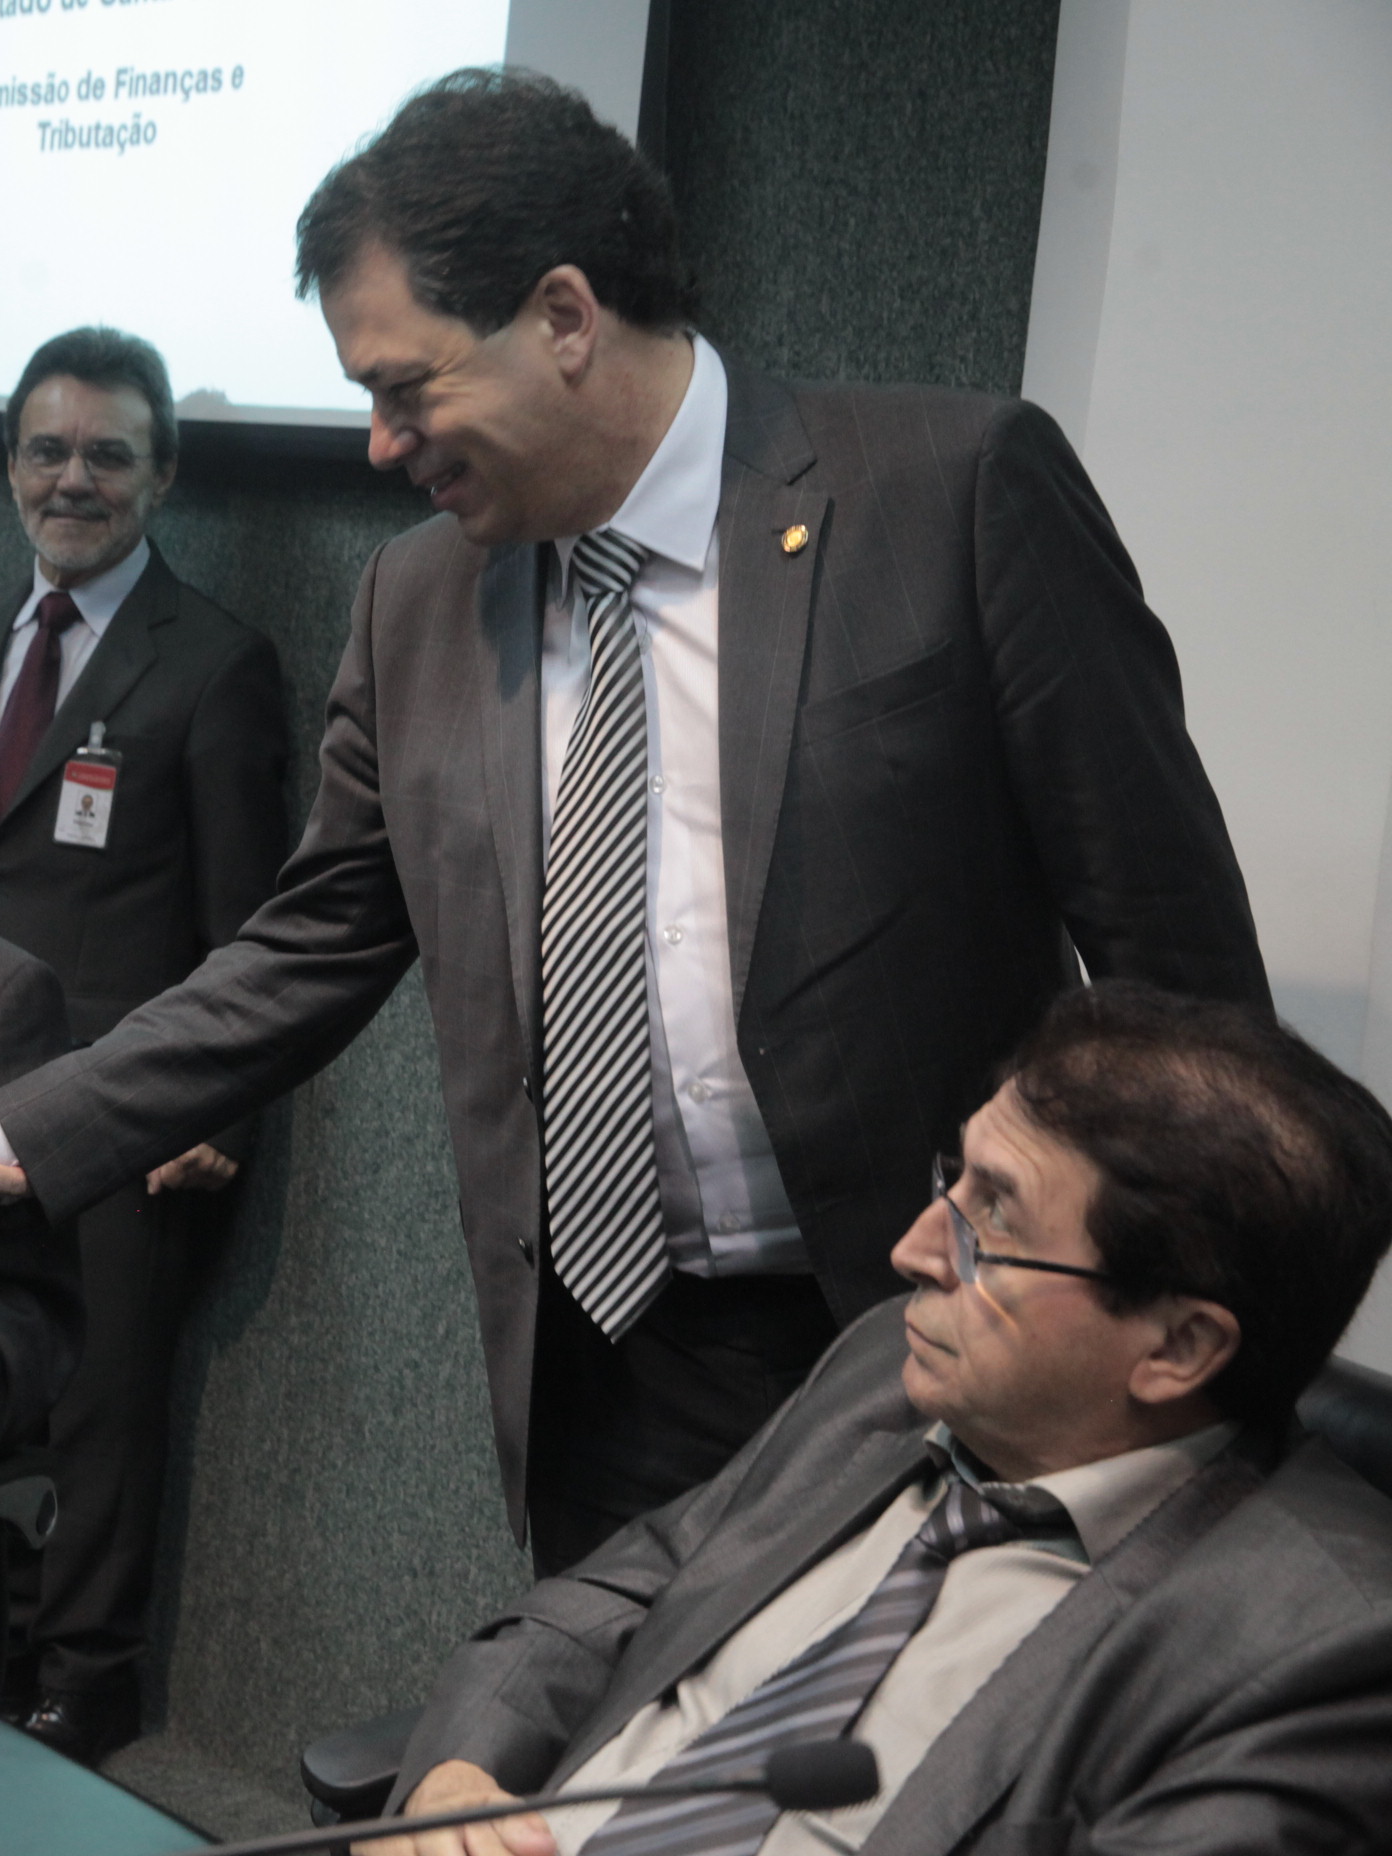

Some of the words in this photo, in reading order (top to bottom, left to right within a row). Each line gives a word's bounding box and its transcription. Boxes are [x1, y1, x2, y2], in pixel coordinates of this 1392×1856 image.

[76, 70, 106, 102] de
[114, 66, 223, 104] Finanças
[231, 64, 245, 90] e
[38, 112, 157, 156] Tributação
